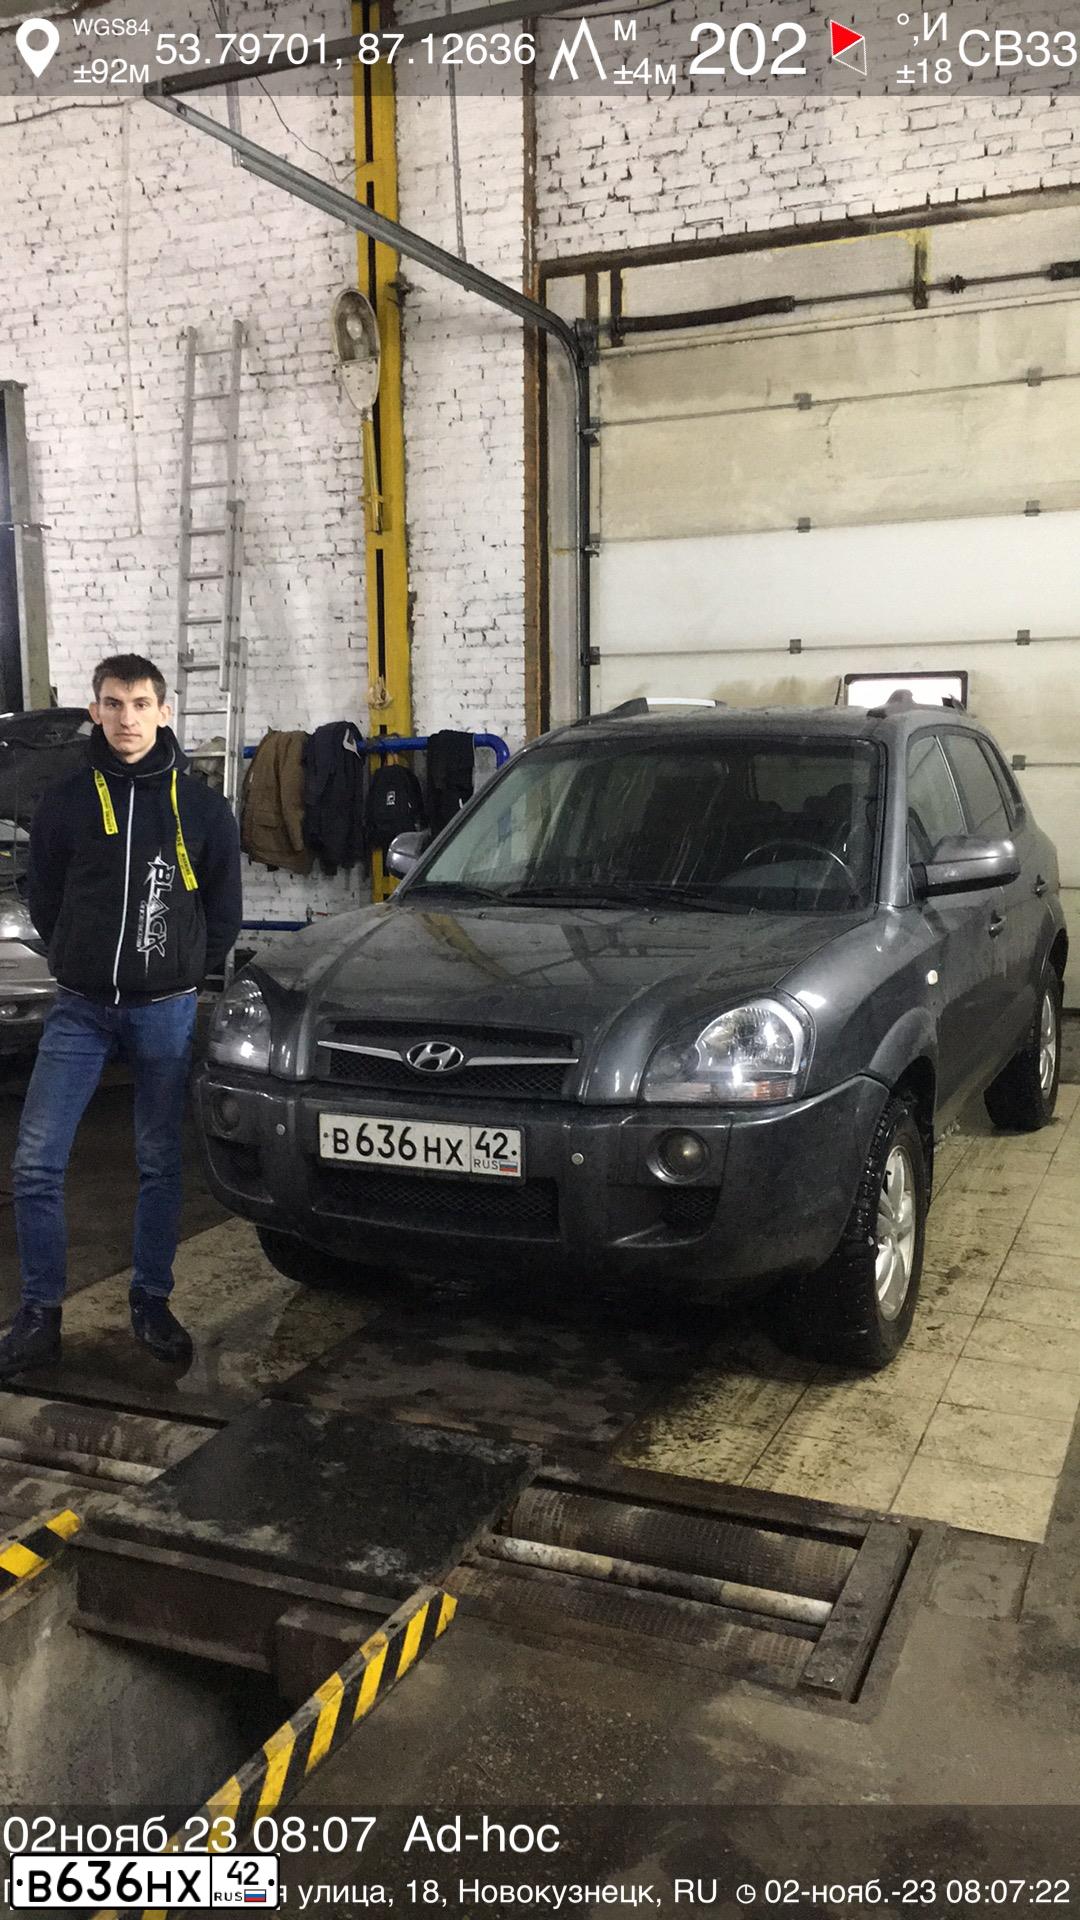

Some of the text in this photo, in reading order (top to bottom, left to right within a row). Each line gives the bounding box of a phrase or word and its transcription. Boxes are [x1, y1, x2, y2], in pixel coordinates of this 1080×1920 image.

[138, 857, 176, 957] BLACK
[475, 1130, 509, 1160] 42
[473, 1158, 499, 1170] RUS
